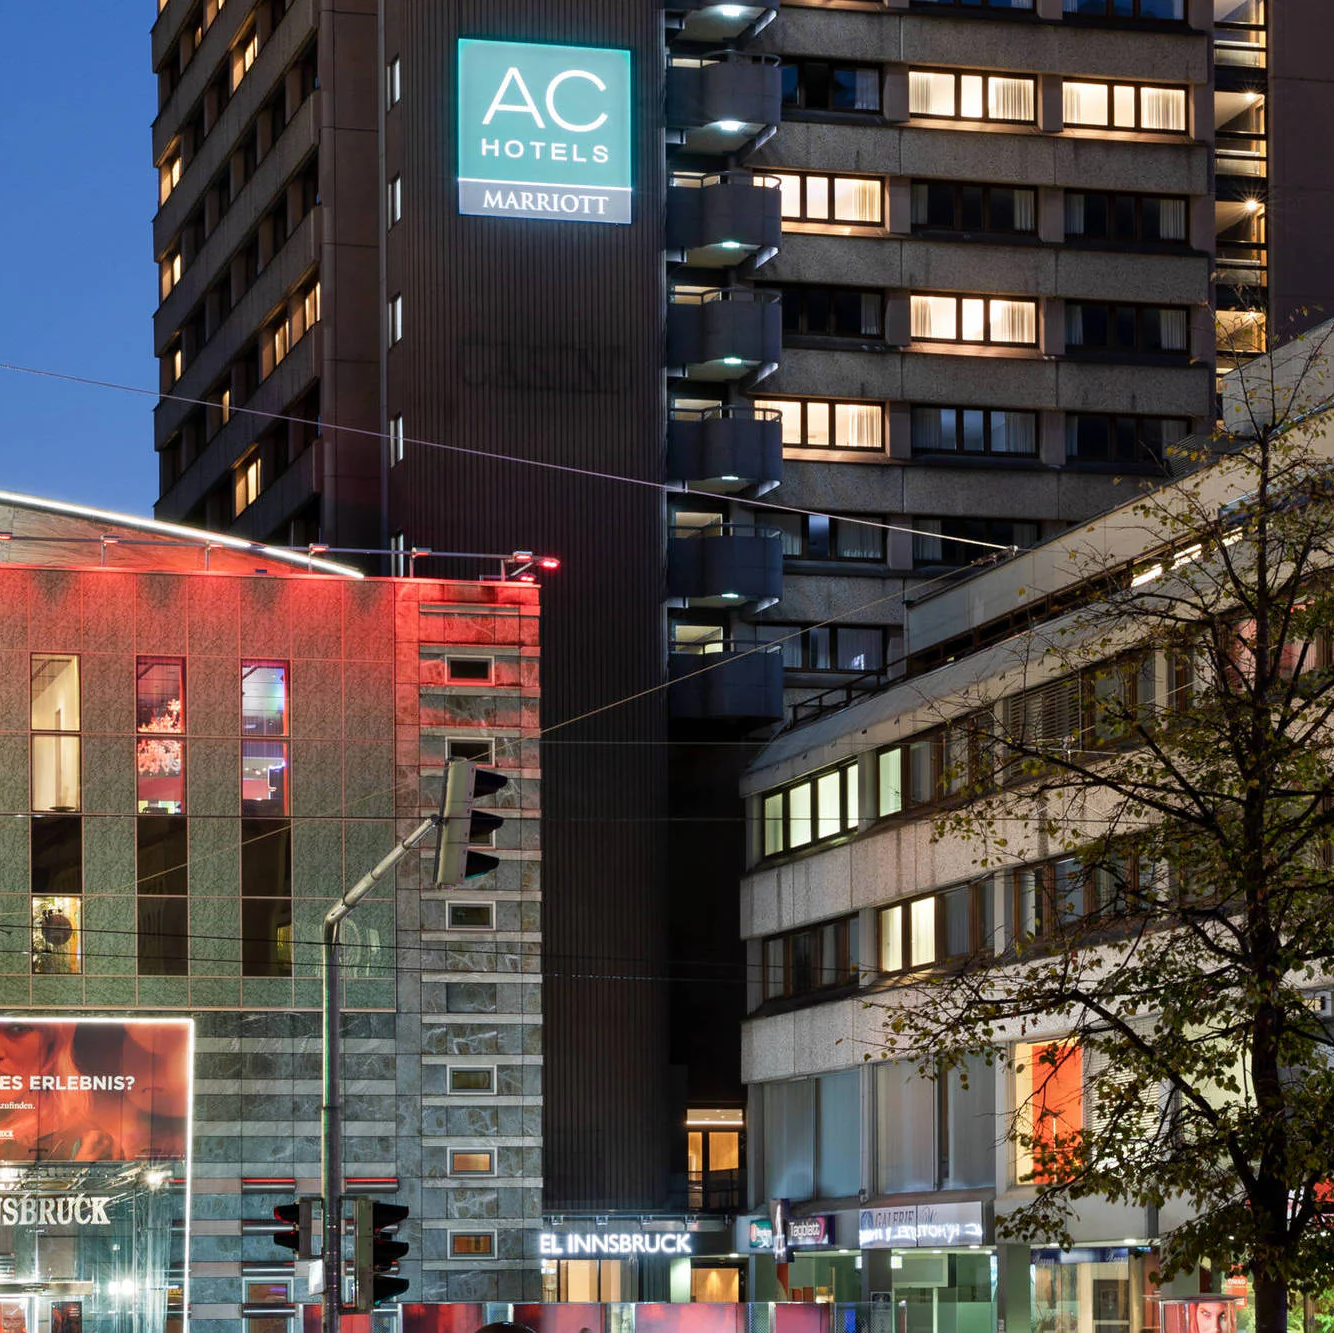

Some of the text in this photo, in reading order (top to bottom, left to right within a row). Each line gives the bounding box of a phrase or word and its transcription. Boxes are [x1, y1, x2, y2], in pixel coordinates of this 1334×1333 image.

[481, 66, 609, 133] AC
[480, 137, 609, 164] HOTELS
[482, 189, 609, 215] MARRIOTT
[28, 1075, 136, 1092] ERLEBNIS?
[788, 1221, 821, 1240] Tagblatt
[567, 1233, 692, 1253] INNSBRUCK
